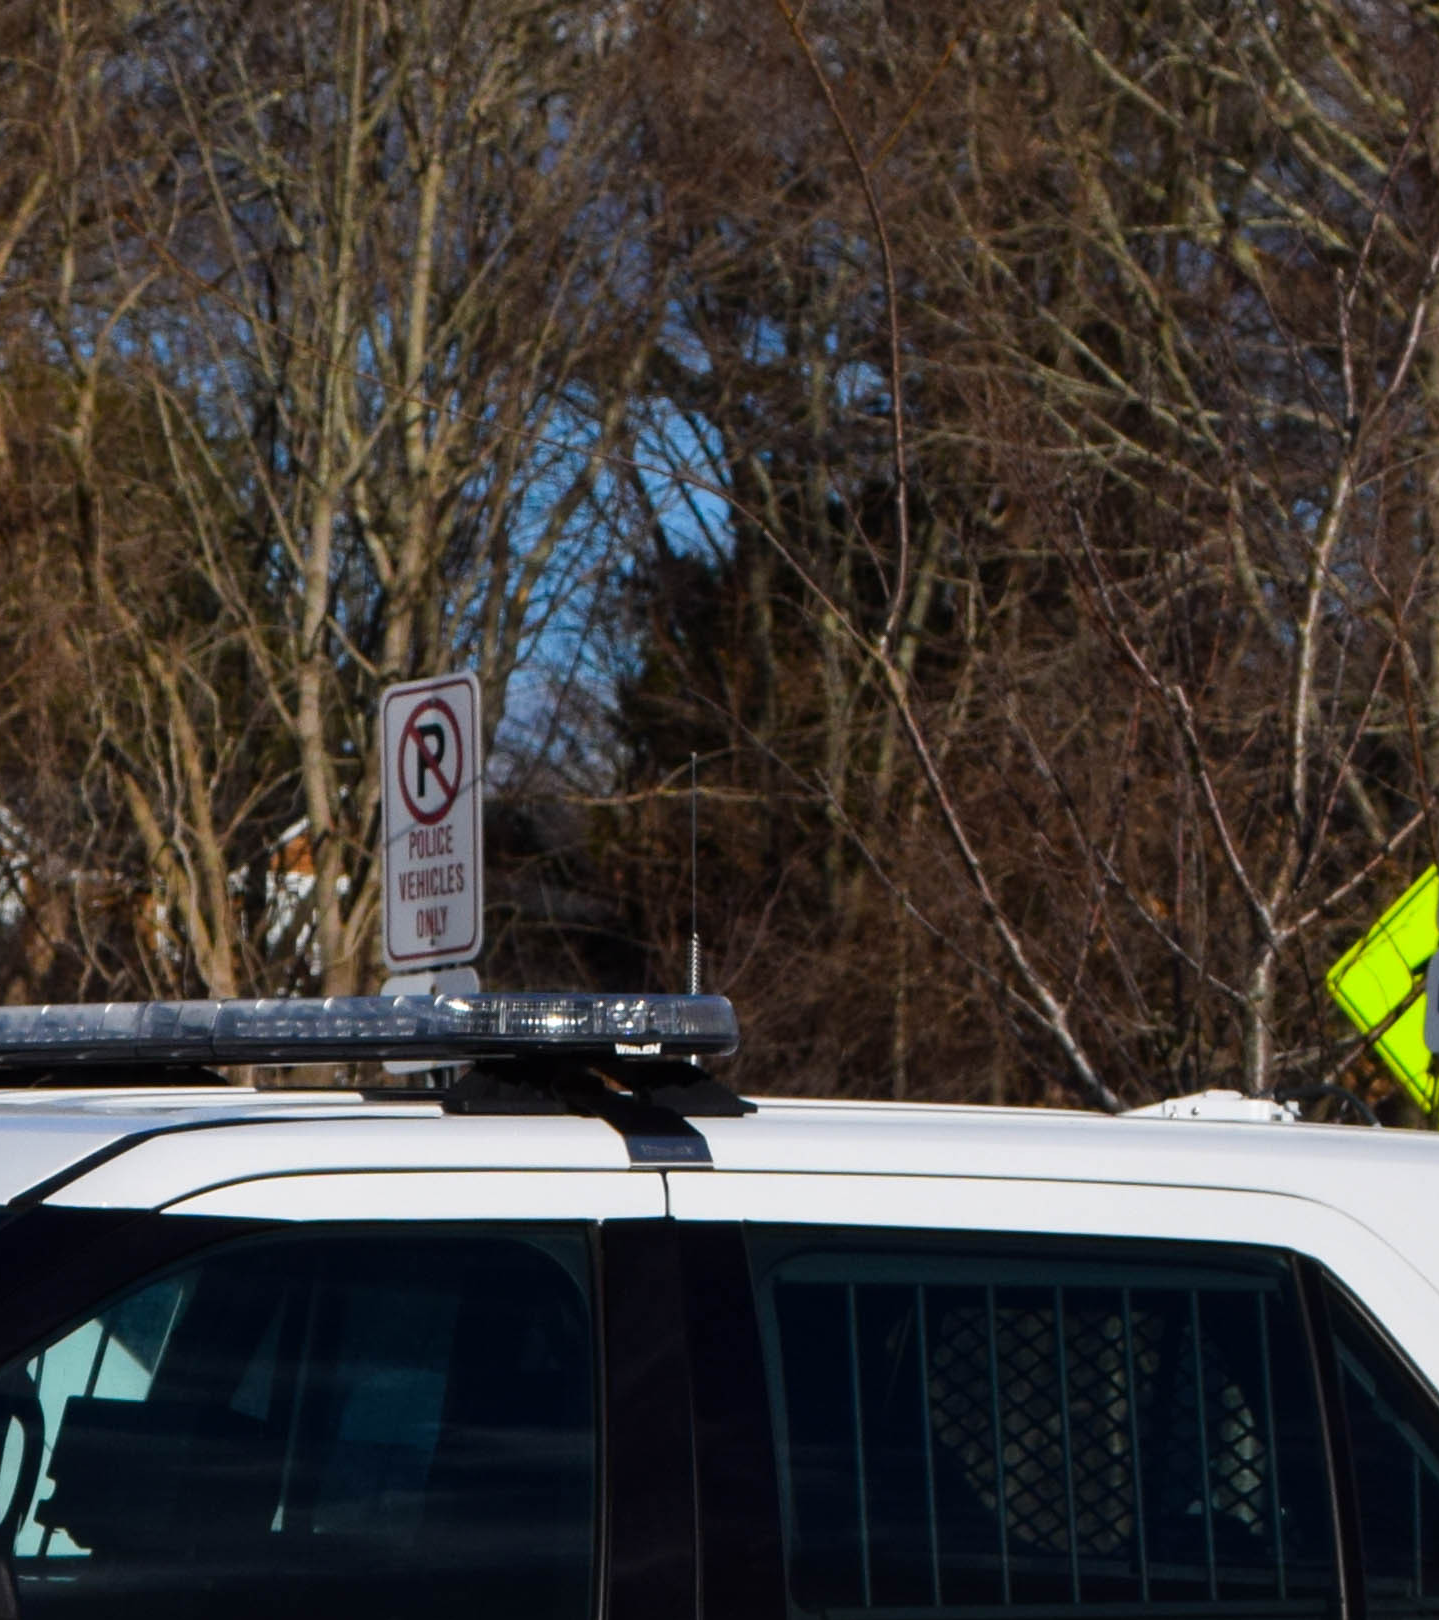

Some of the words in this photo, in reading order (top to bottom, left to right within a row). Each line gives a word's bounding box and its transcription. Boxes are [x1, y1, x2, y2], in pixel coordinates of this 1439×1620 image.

[408, 825, 454, 860] POLICE
[398, 863, 465, 902] VEHICLES
[415, 906, 449, 939] ONLY
